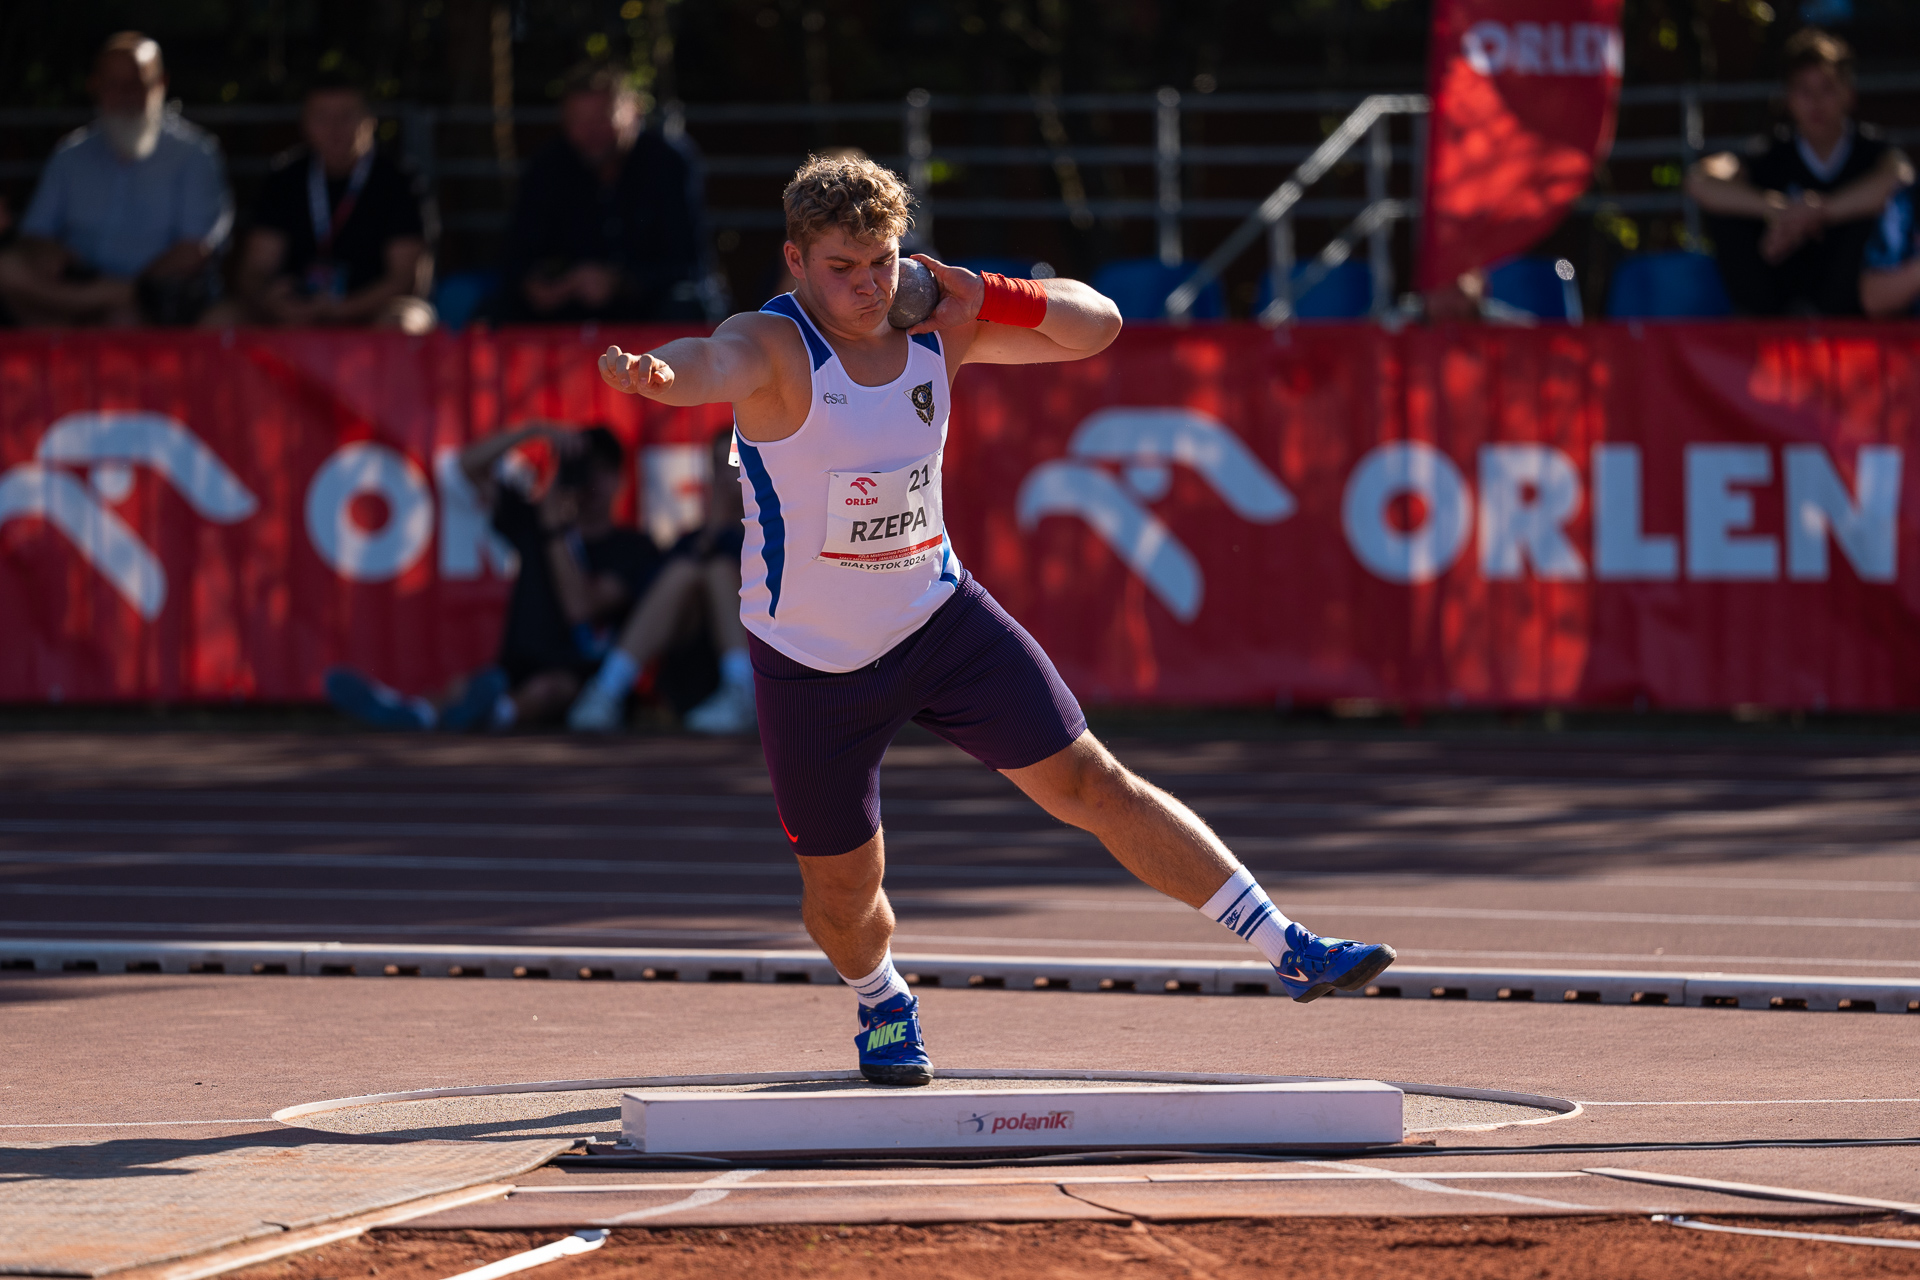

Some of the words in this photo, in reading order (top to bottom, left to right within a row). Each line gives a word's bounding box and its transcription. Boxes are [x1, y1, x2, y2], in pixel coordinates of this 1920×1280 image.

[908, 464, 931, 493] 21
[845, 496, 878, 506] ORLEN
[1343, 440, 1903, 582] ORLEN
[850, 506, 928, 543] RZEPA
[840, 561, 901, 571] BIAŁYSTOK
[903, 554, 926, 567] 2024
[866, 1021, 908, 1052] NIKE
[991, 1112, 1068, 1134] polanik
